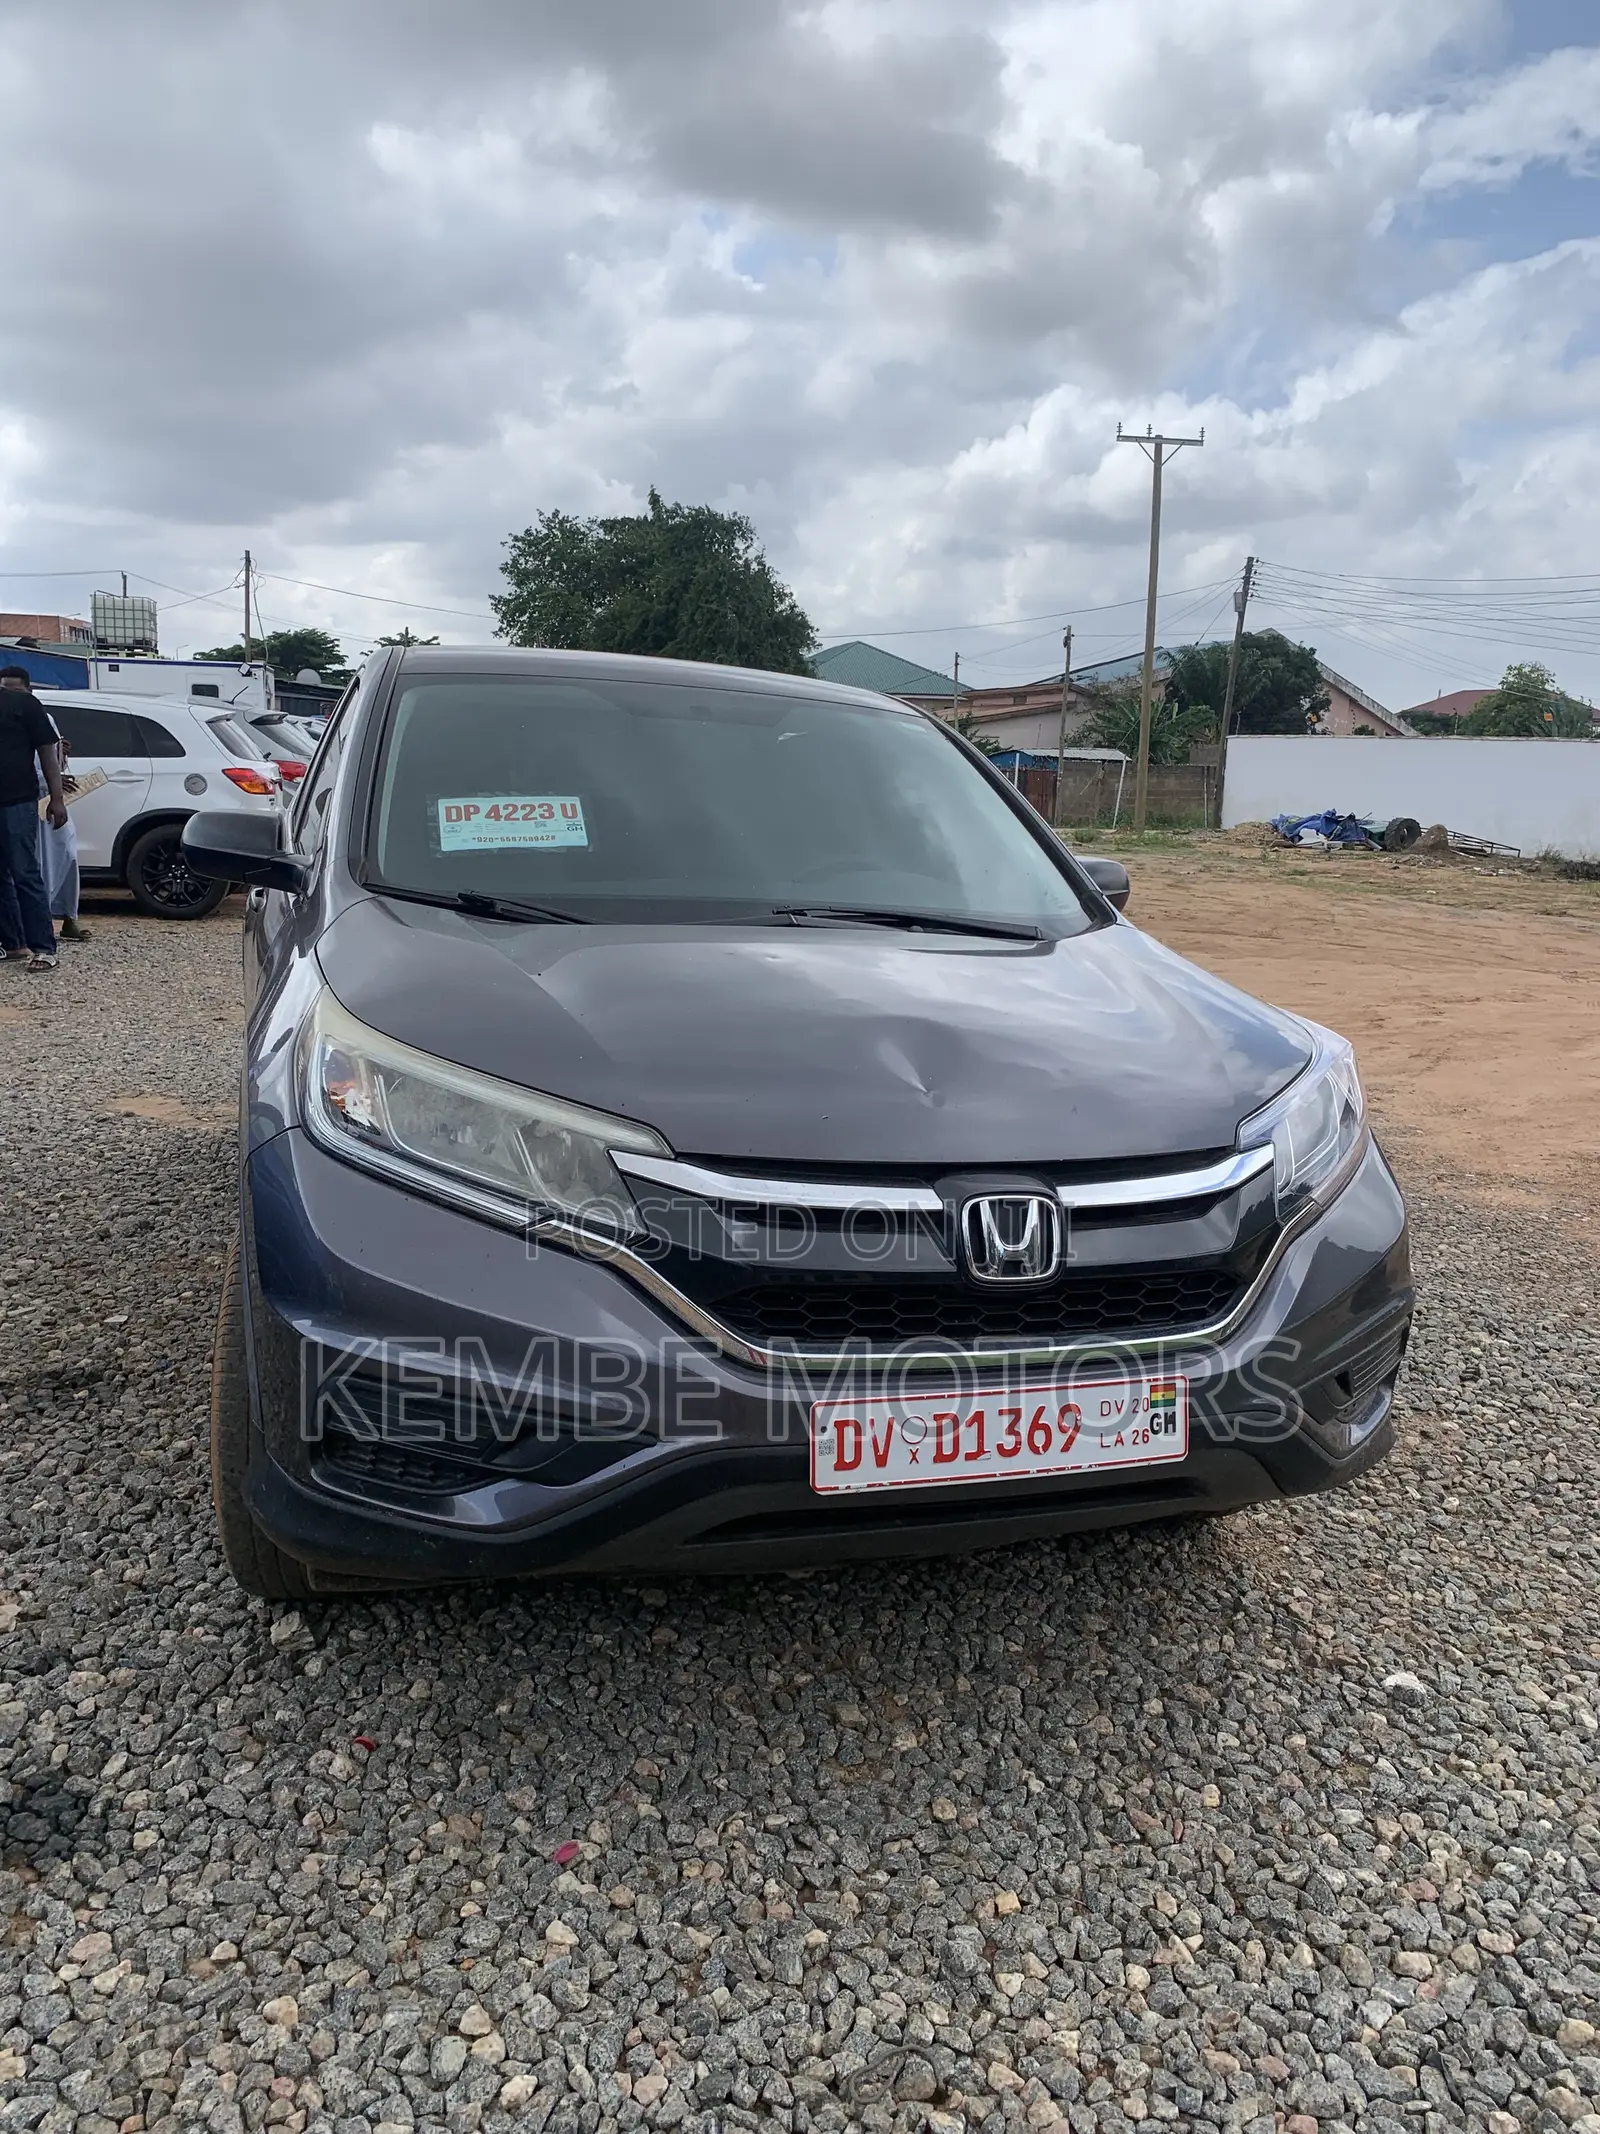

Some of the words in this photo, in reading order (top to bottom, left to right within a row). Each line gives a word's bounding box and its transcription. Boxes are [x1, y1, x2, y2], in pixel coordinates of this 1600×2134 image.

[445, 804, 480, 823] DP
[485, 803, 555, 821] 4223
[560, 803, 578, 820] U
[1100, 1397, 1123, 1418] DV
[1131, 1396, 1150, 1414] 20
[1149, 1410, 1177, 1436] GH
[833, 1417, 896, 1471] DV
[932, 1402, 1082, 1464] D1369
[1100, 1431, 1124, 1449] LA
[1131, 1427, 1151, 1445] 26
